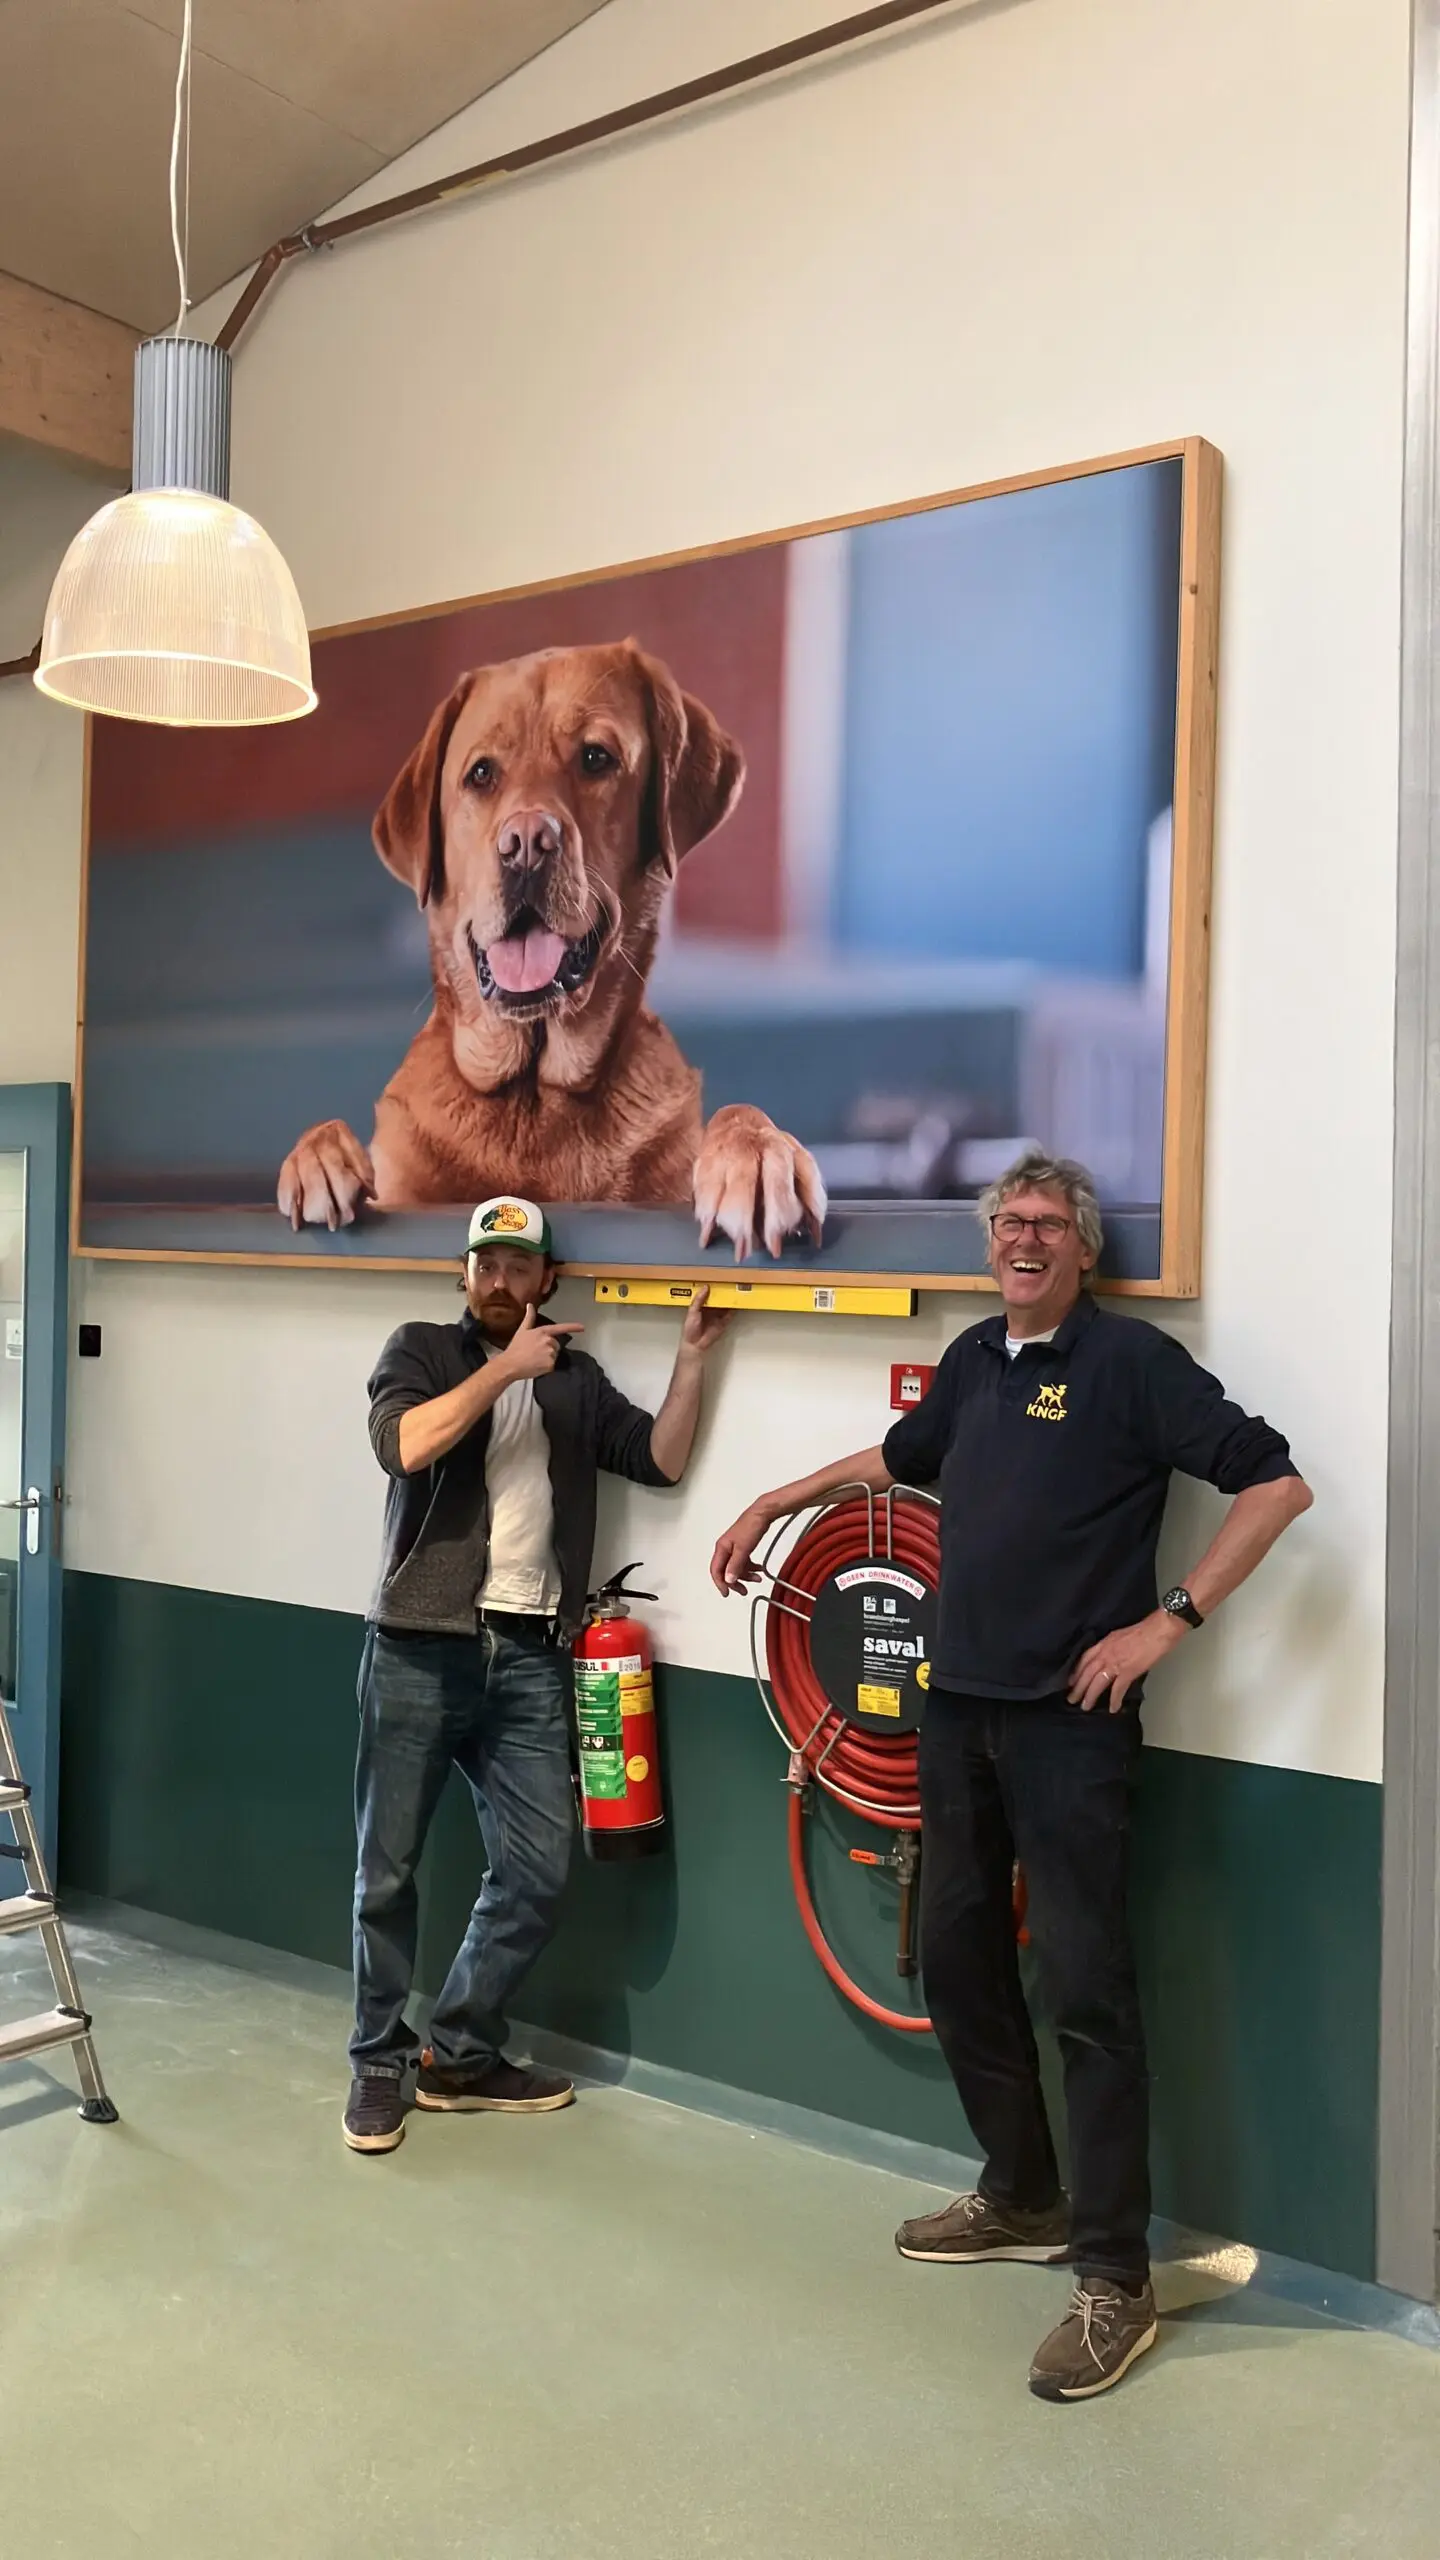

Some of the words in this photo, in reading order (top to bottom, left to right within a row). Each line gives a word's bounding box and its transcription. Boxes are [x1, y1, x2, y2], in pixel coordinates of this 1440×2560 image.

[500, 1205, 521, 1214] Bass
[501, 1212, 515, 1220] Pro
[501, 1219, 524, 1229] Shops
[1026, 1403, 1068, 1421] KNGF
[846, 1572, 865, 1582] GEEN
[868, 1571, 915, 1590] DRINKWATER
[863, 1635, 925, 1659] saval
